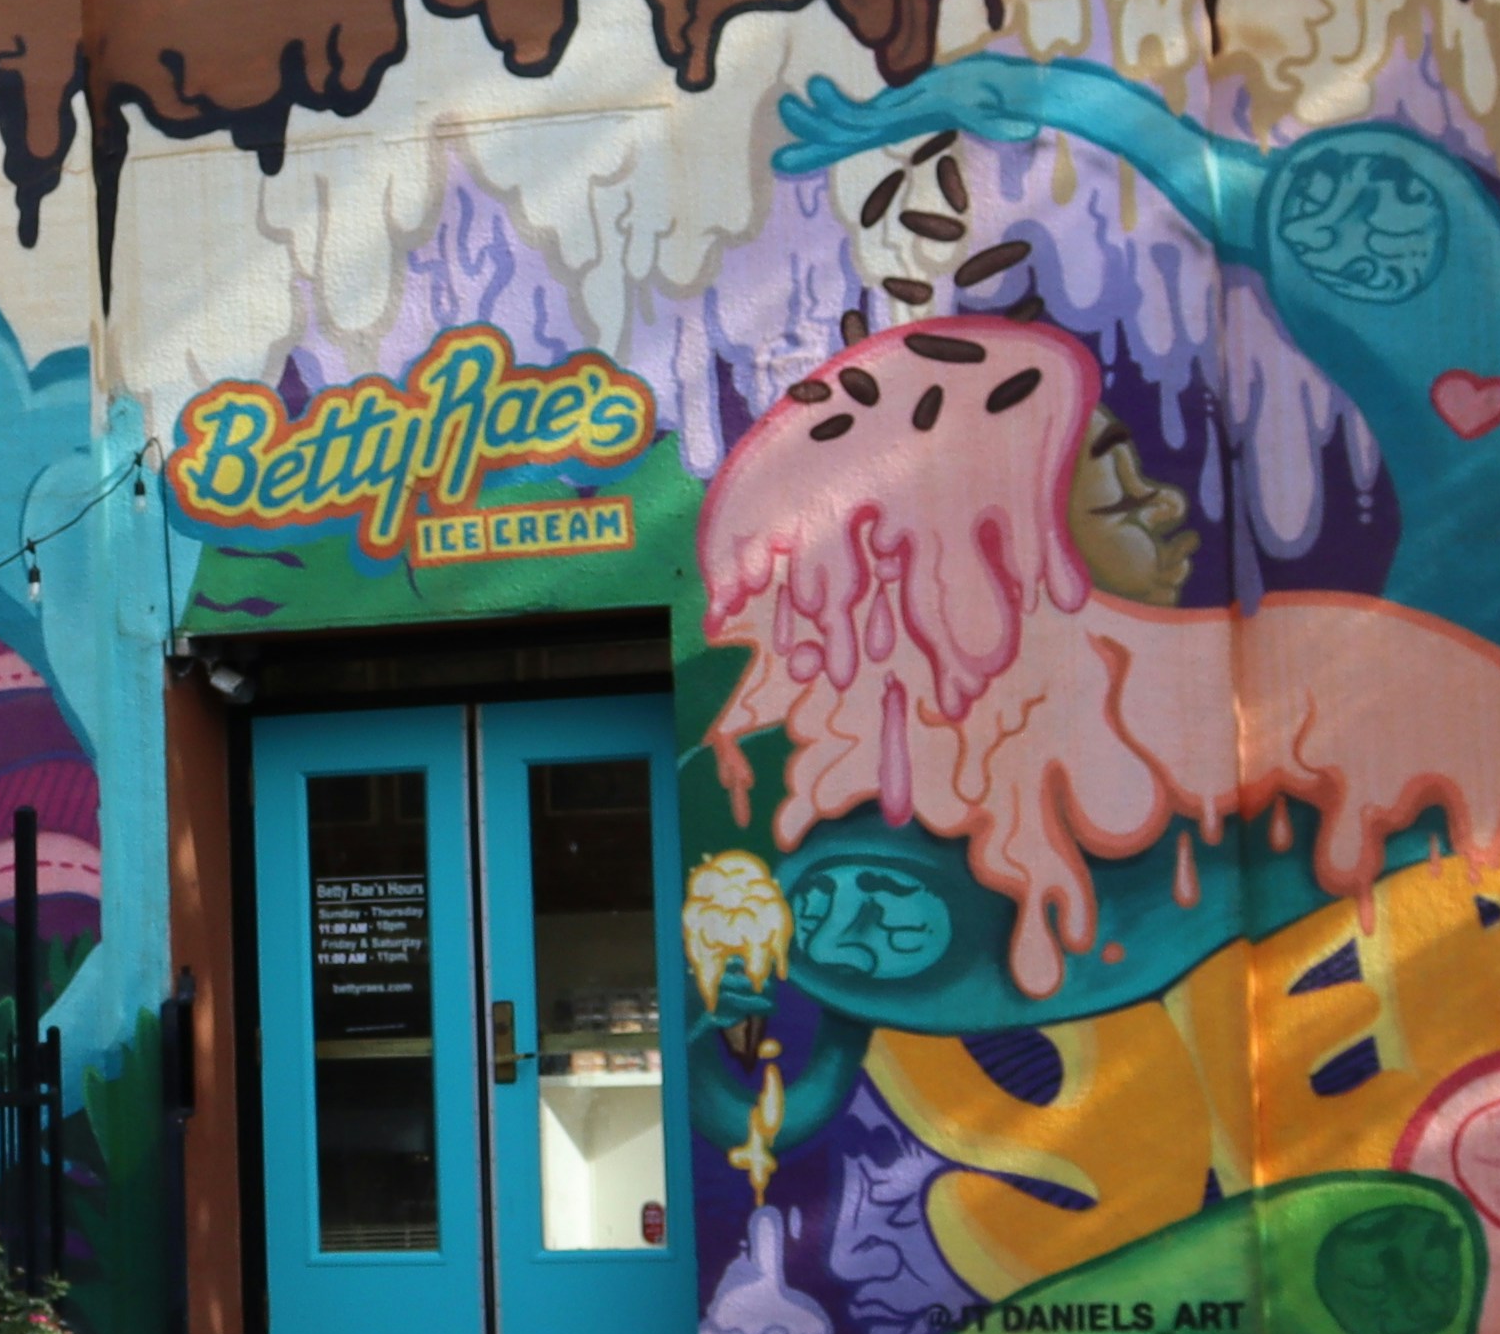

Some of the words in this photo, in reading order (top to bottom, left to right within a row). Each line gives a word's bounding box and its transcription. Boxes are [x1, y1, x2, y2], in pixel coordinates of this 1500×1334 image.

[183, 395, 423, 537] Betty
[420, 342, 637, 496] Rae's
[423, 523, 481, 552] ICE
[494, 508, 624, 548] CREAM
[317, 884, 349, 902] Betty
[351, 882, 385, 897] Rae's
[388, 882, 424, 896] Hours
[319, 908, 361, 921] Sunday
[371, 906, 424, 919] Thursday
[349, 922, 368, 934] AM
[321, 938, 357, 951] Friday
[371, 937, 422, 951] Saturday
[348, 952, 367, 964] AM
[927, 1302, 991, 1334] @JT
